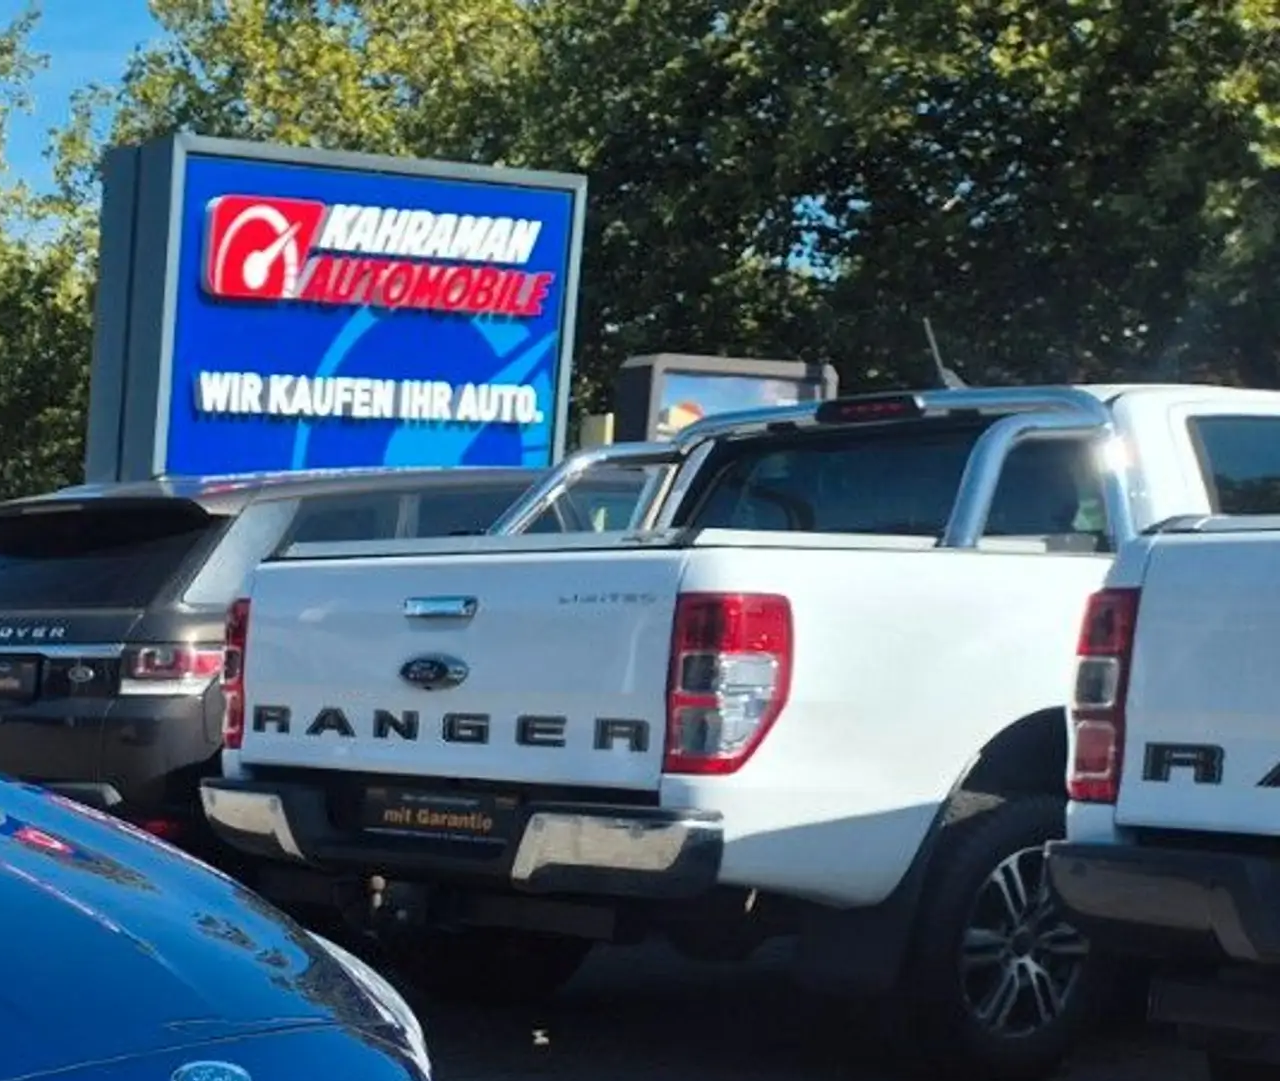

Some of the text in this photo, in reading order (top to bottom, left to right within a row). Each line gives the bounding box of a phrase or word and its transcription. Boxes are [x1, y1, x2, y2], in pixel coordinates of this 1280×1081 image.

[318, 204, 542, 265] KAHRAMAN
[299, 256, 555, 317] AUTOMOBILE
[199, 370, 546, 424] WIR KAUFEN IHR AUTO.
[252, 704, 650, 752] RANGER
[383, 806, 493, 833] mit Garantie
